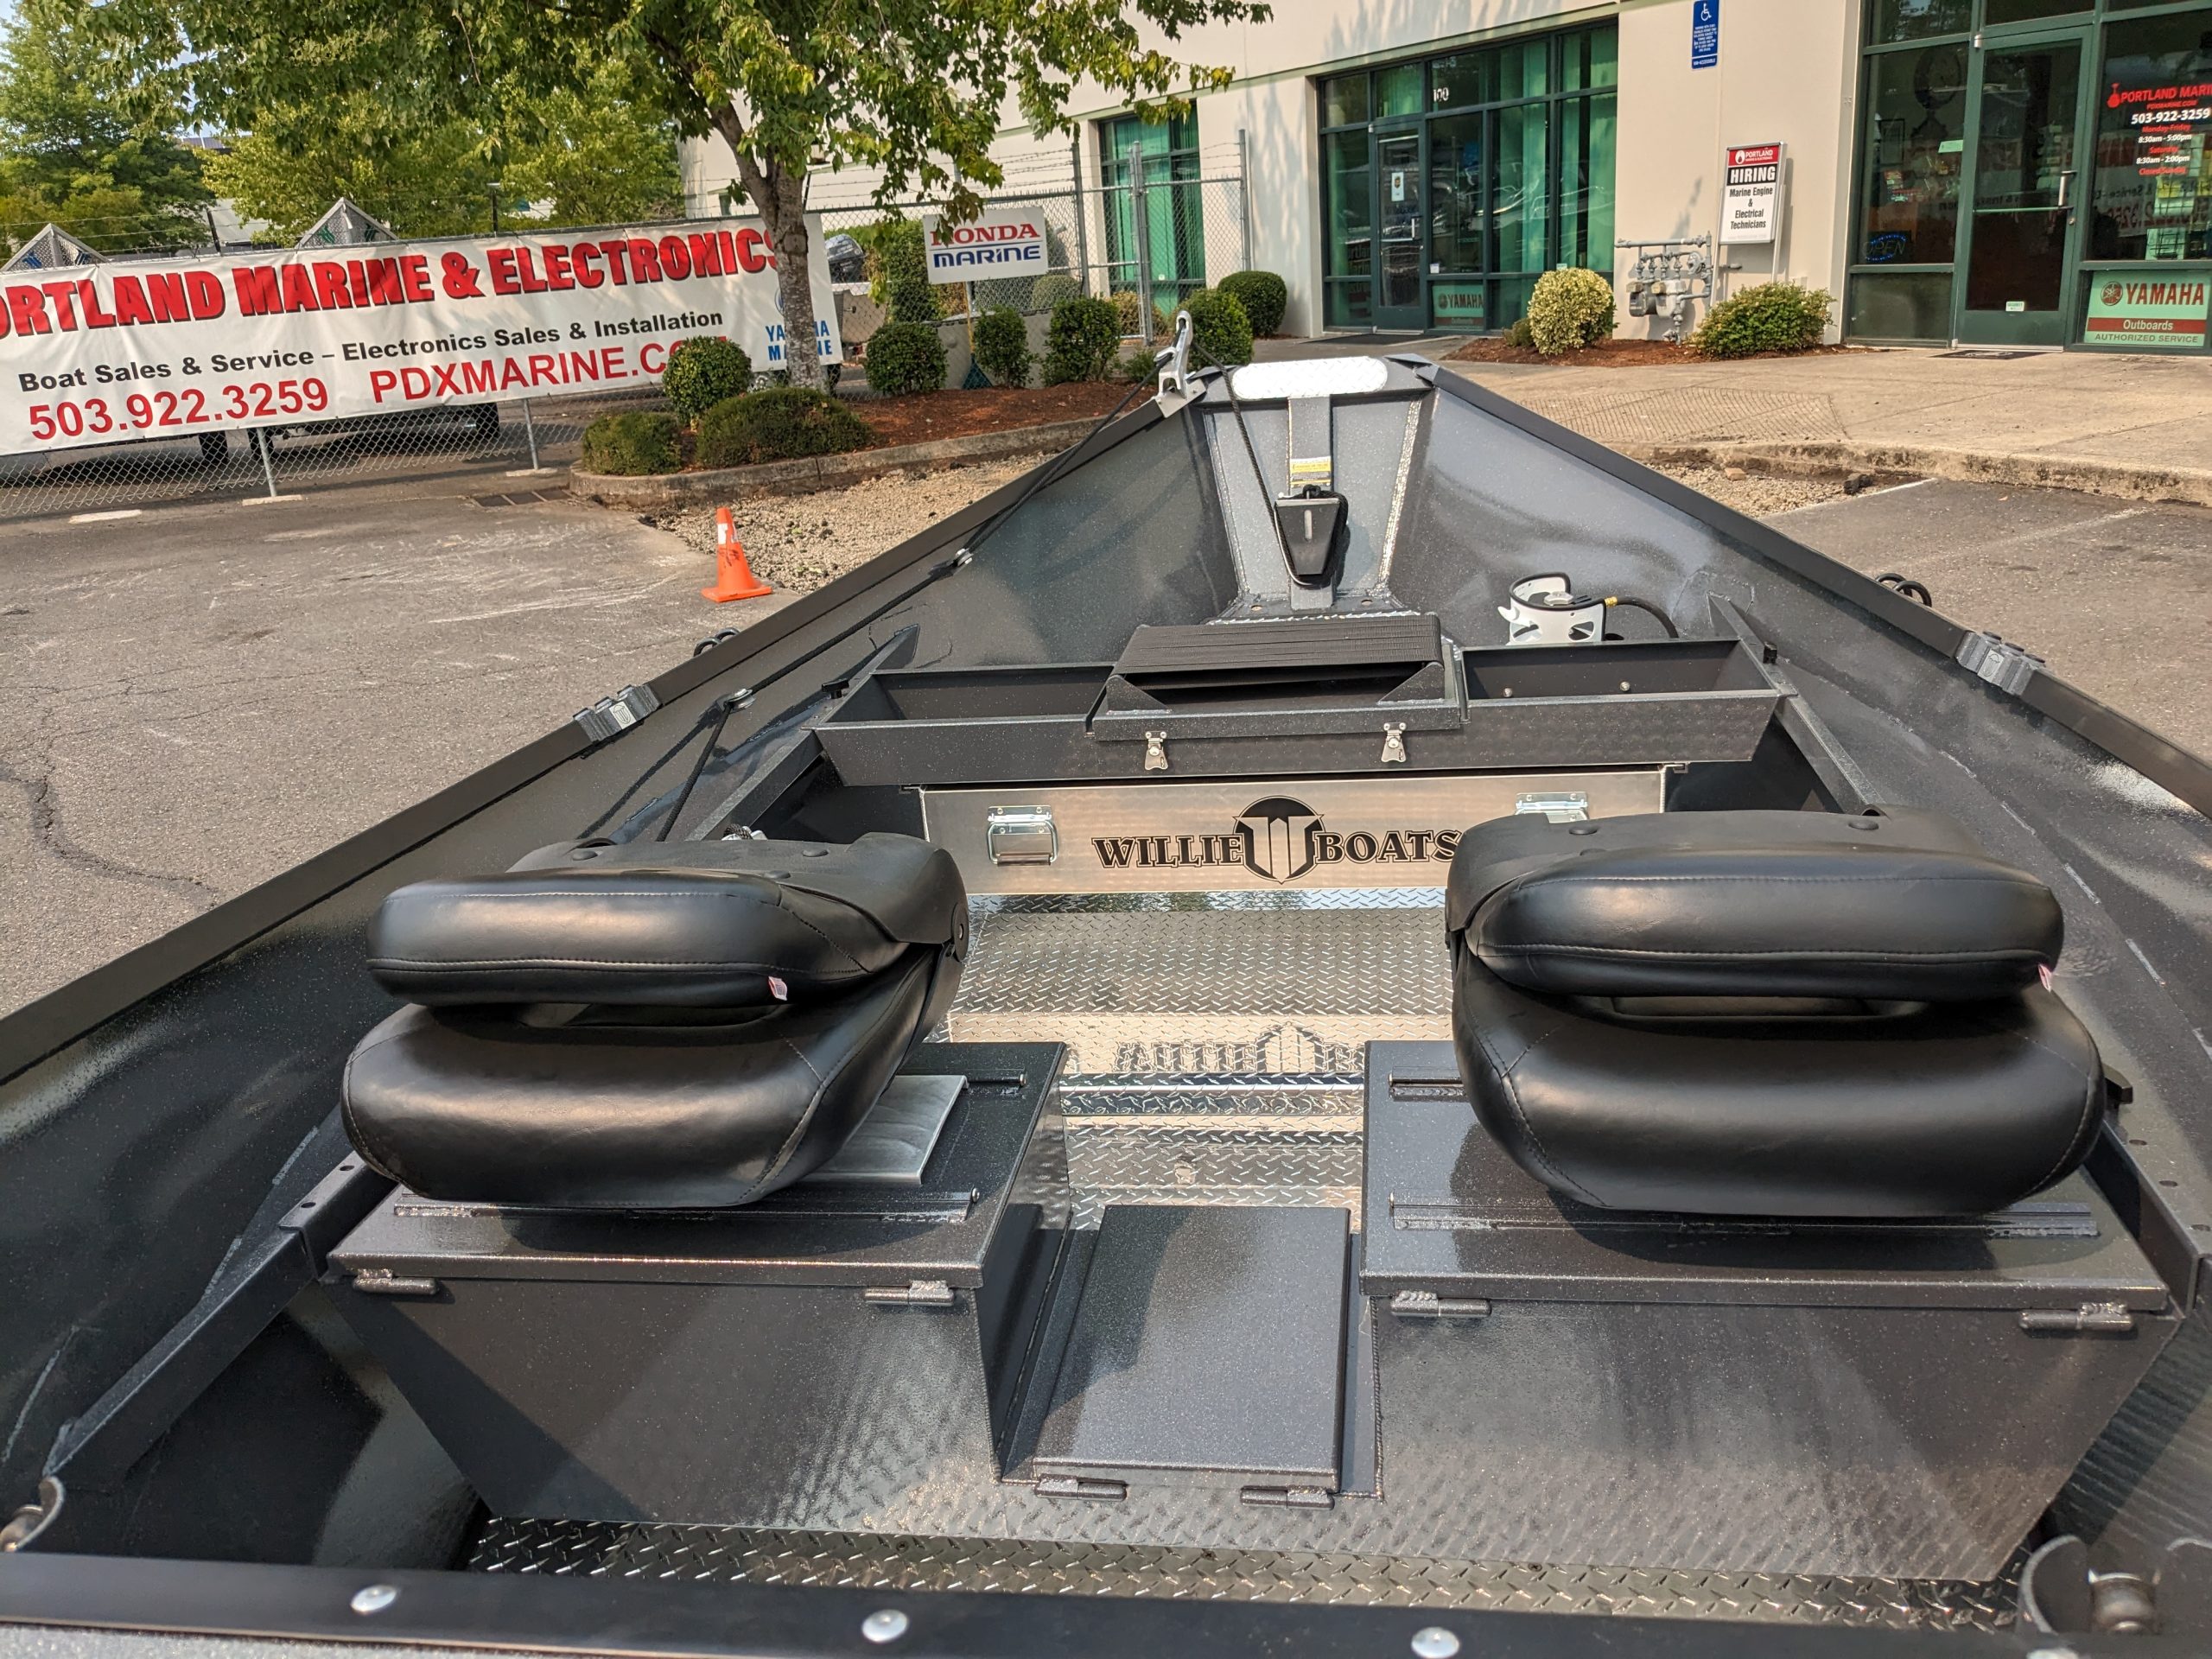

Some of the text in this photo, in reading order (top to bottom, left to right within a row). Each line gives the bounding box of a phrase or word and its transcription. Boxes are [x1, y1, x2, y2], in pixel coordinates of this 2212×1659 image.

[1433, 87, 1449, 102] 100
[2120, 87, 2177, 103] PORTLAND
[2131, 107, 2211, 124] 503-922-3259
[1745, 149, 1773, 158] PORTLAND
[1730, 166, 1776, 184] HIRING
[1729, 187, 1773, 197] Marine Engine
[1748, 198, 1753, 207] &
[1735, 208, 1764, 219] Electrical
[1731, 220, 1766, 230] Technicians
[933, 245, 1041, 268] MARINE
[0, 270, 226, 340] RTLAND
[232, 254, 434, 316] MARINE
[442, 251, 485, 299] &
[1447, 294, 1484, 308] YAMAHA
[2126, 283, 2204, 305] YAMAHA
[765, 320, 830, 342] YAA
[2123, 319, 2174, 330] Outboards
[2094, 334, 2198, 343] AUTHORIZED SERVICE
[18, 366, 87, 392] Boat
[95, 361, 171, 384] Sales
[181, 356, 202, 375] &
[212, 347, 315, 372] Service
[342, 334, 486, 361] Electronics
[494, 327, 559, 346] Sales
[569, 322, 586, 340] &
[594, 310, 723, 337] Installation
[29, 335, 727, 441] 503.922.3259 PDXMARINE.C
[1091, 830, 1462, 868] WILLIE BOATS
